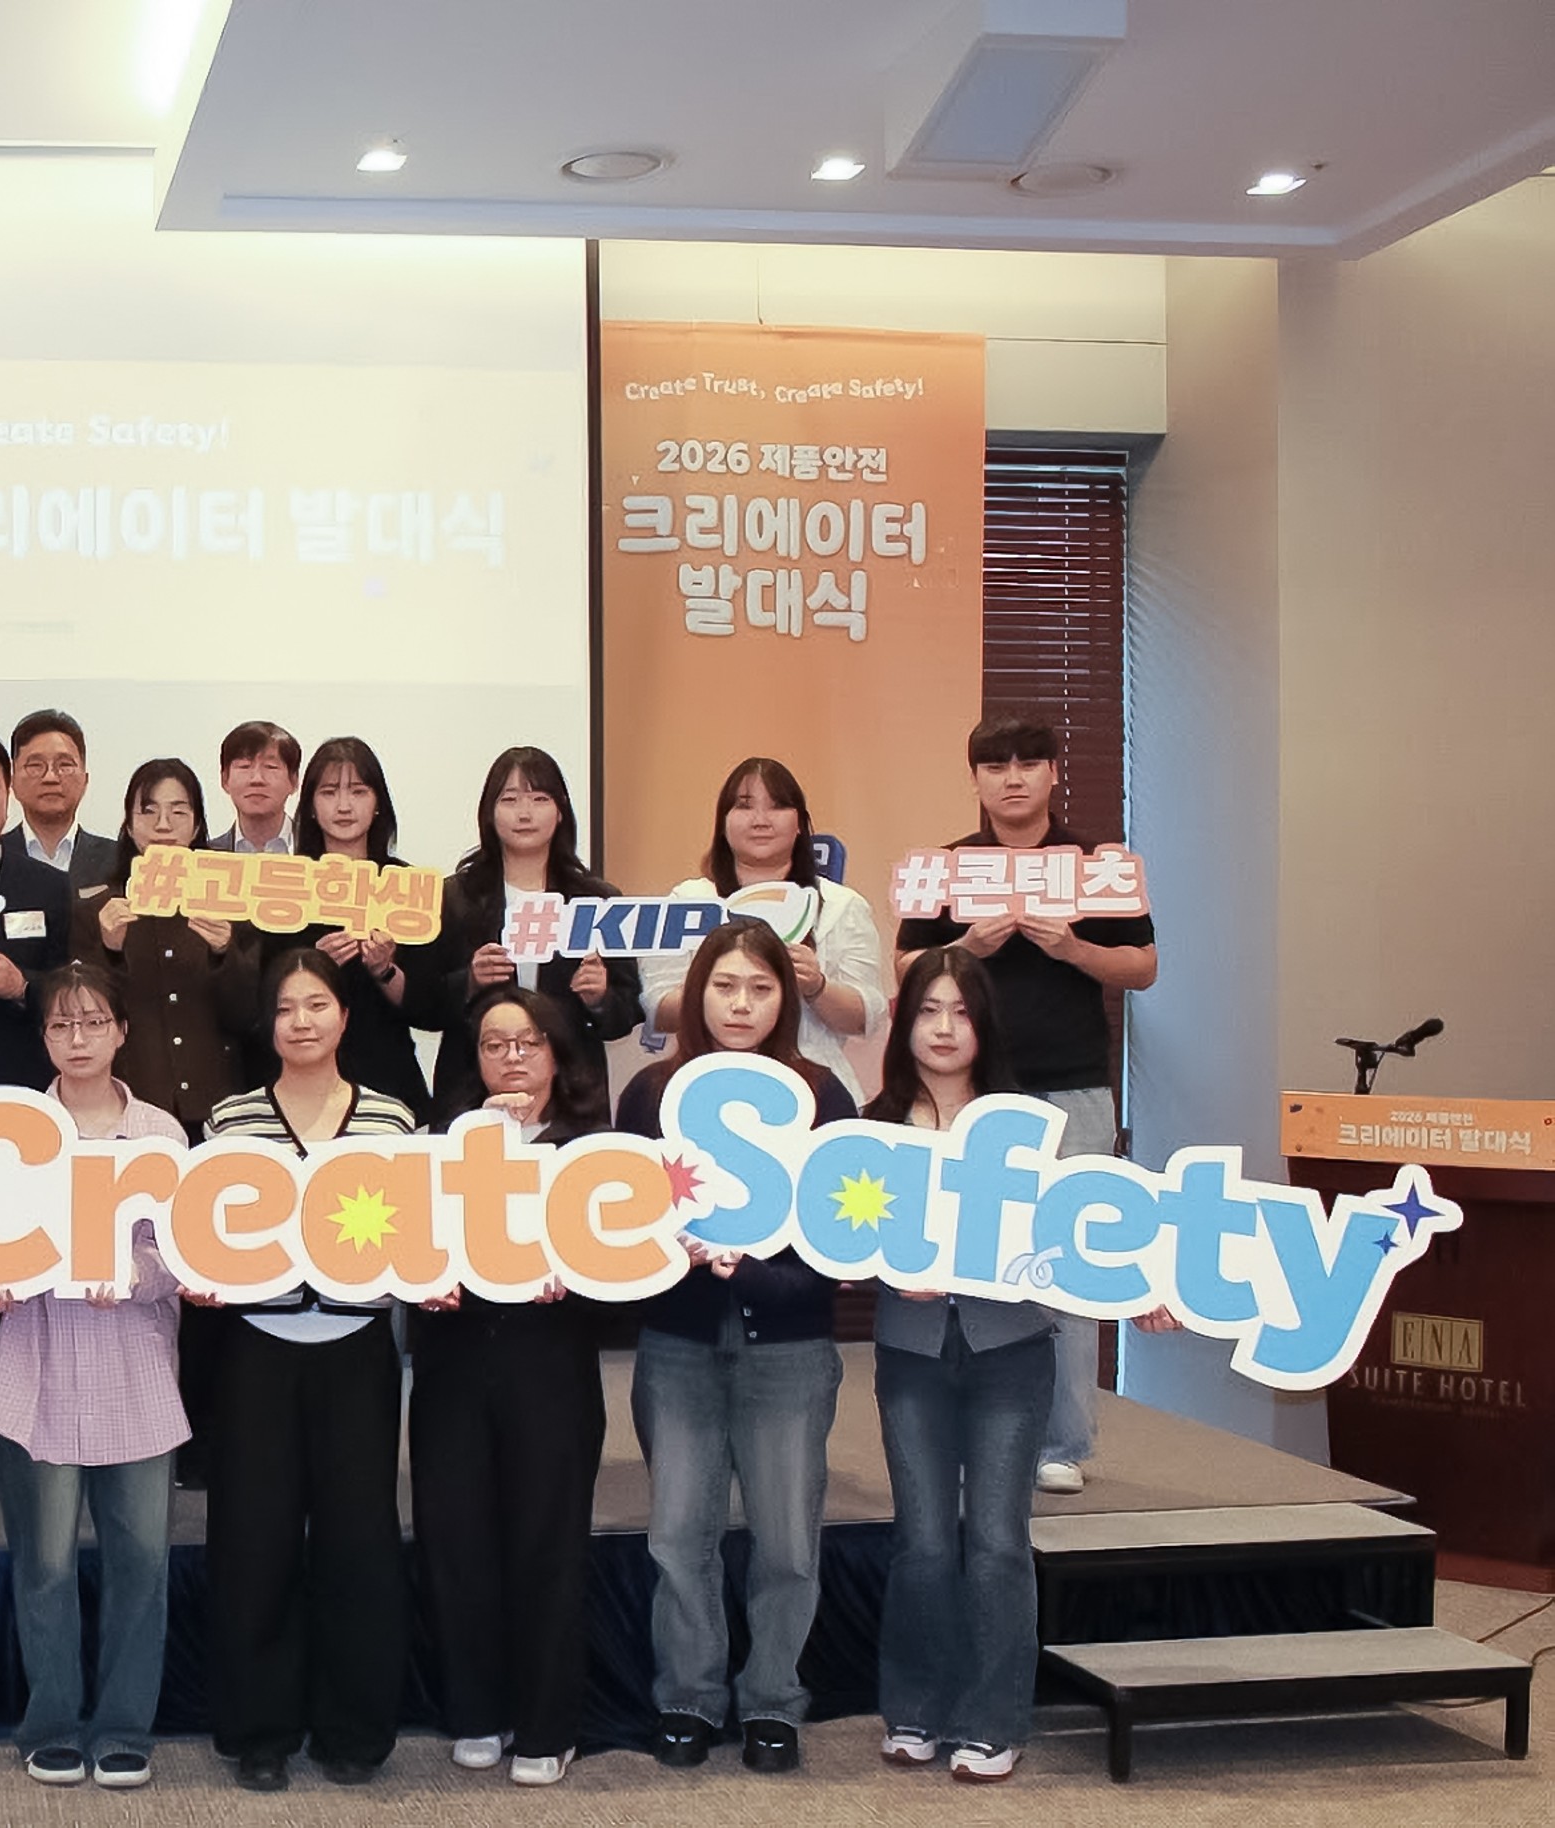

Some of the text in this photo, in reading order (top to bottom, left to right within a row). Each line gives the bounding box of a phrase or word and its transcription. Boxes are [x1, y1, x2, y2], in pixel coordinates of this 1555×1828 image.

[624, 371, 925, 404] Create Trust, Create Safety!
[87, 414, 231, 454] Safety!
[656, 440, 888, 483] 2026 제품안전
[289, 489, 506, 568] 발대식
[617, 494, 927, 566] 크리에이터
[677, 562, 868, 643] 발대식
[132, 852, 436, 939] #고등학생
[896, 845, 1143, 914] #콘텐츠
[677, 1067, 1399, 1374] Safety
[1402, 1321, 1474, 1364] ENA
[1439, 1374, 1527, 1408] HOTEL
